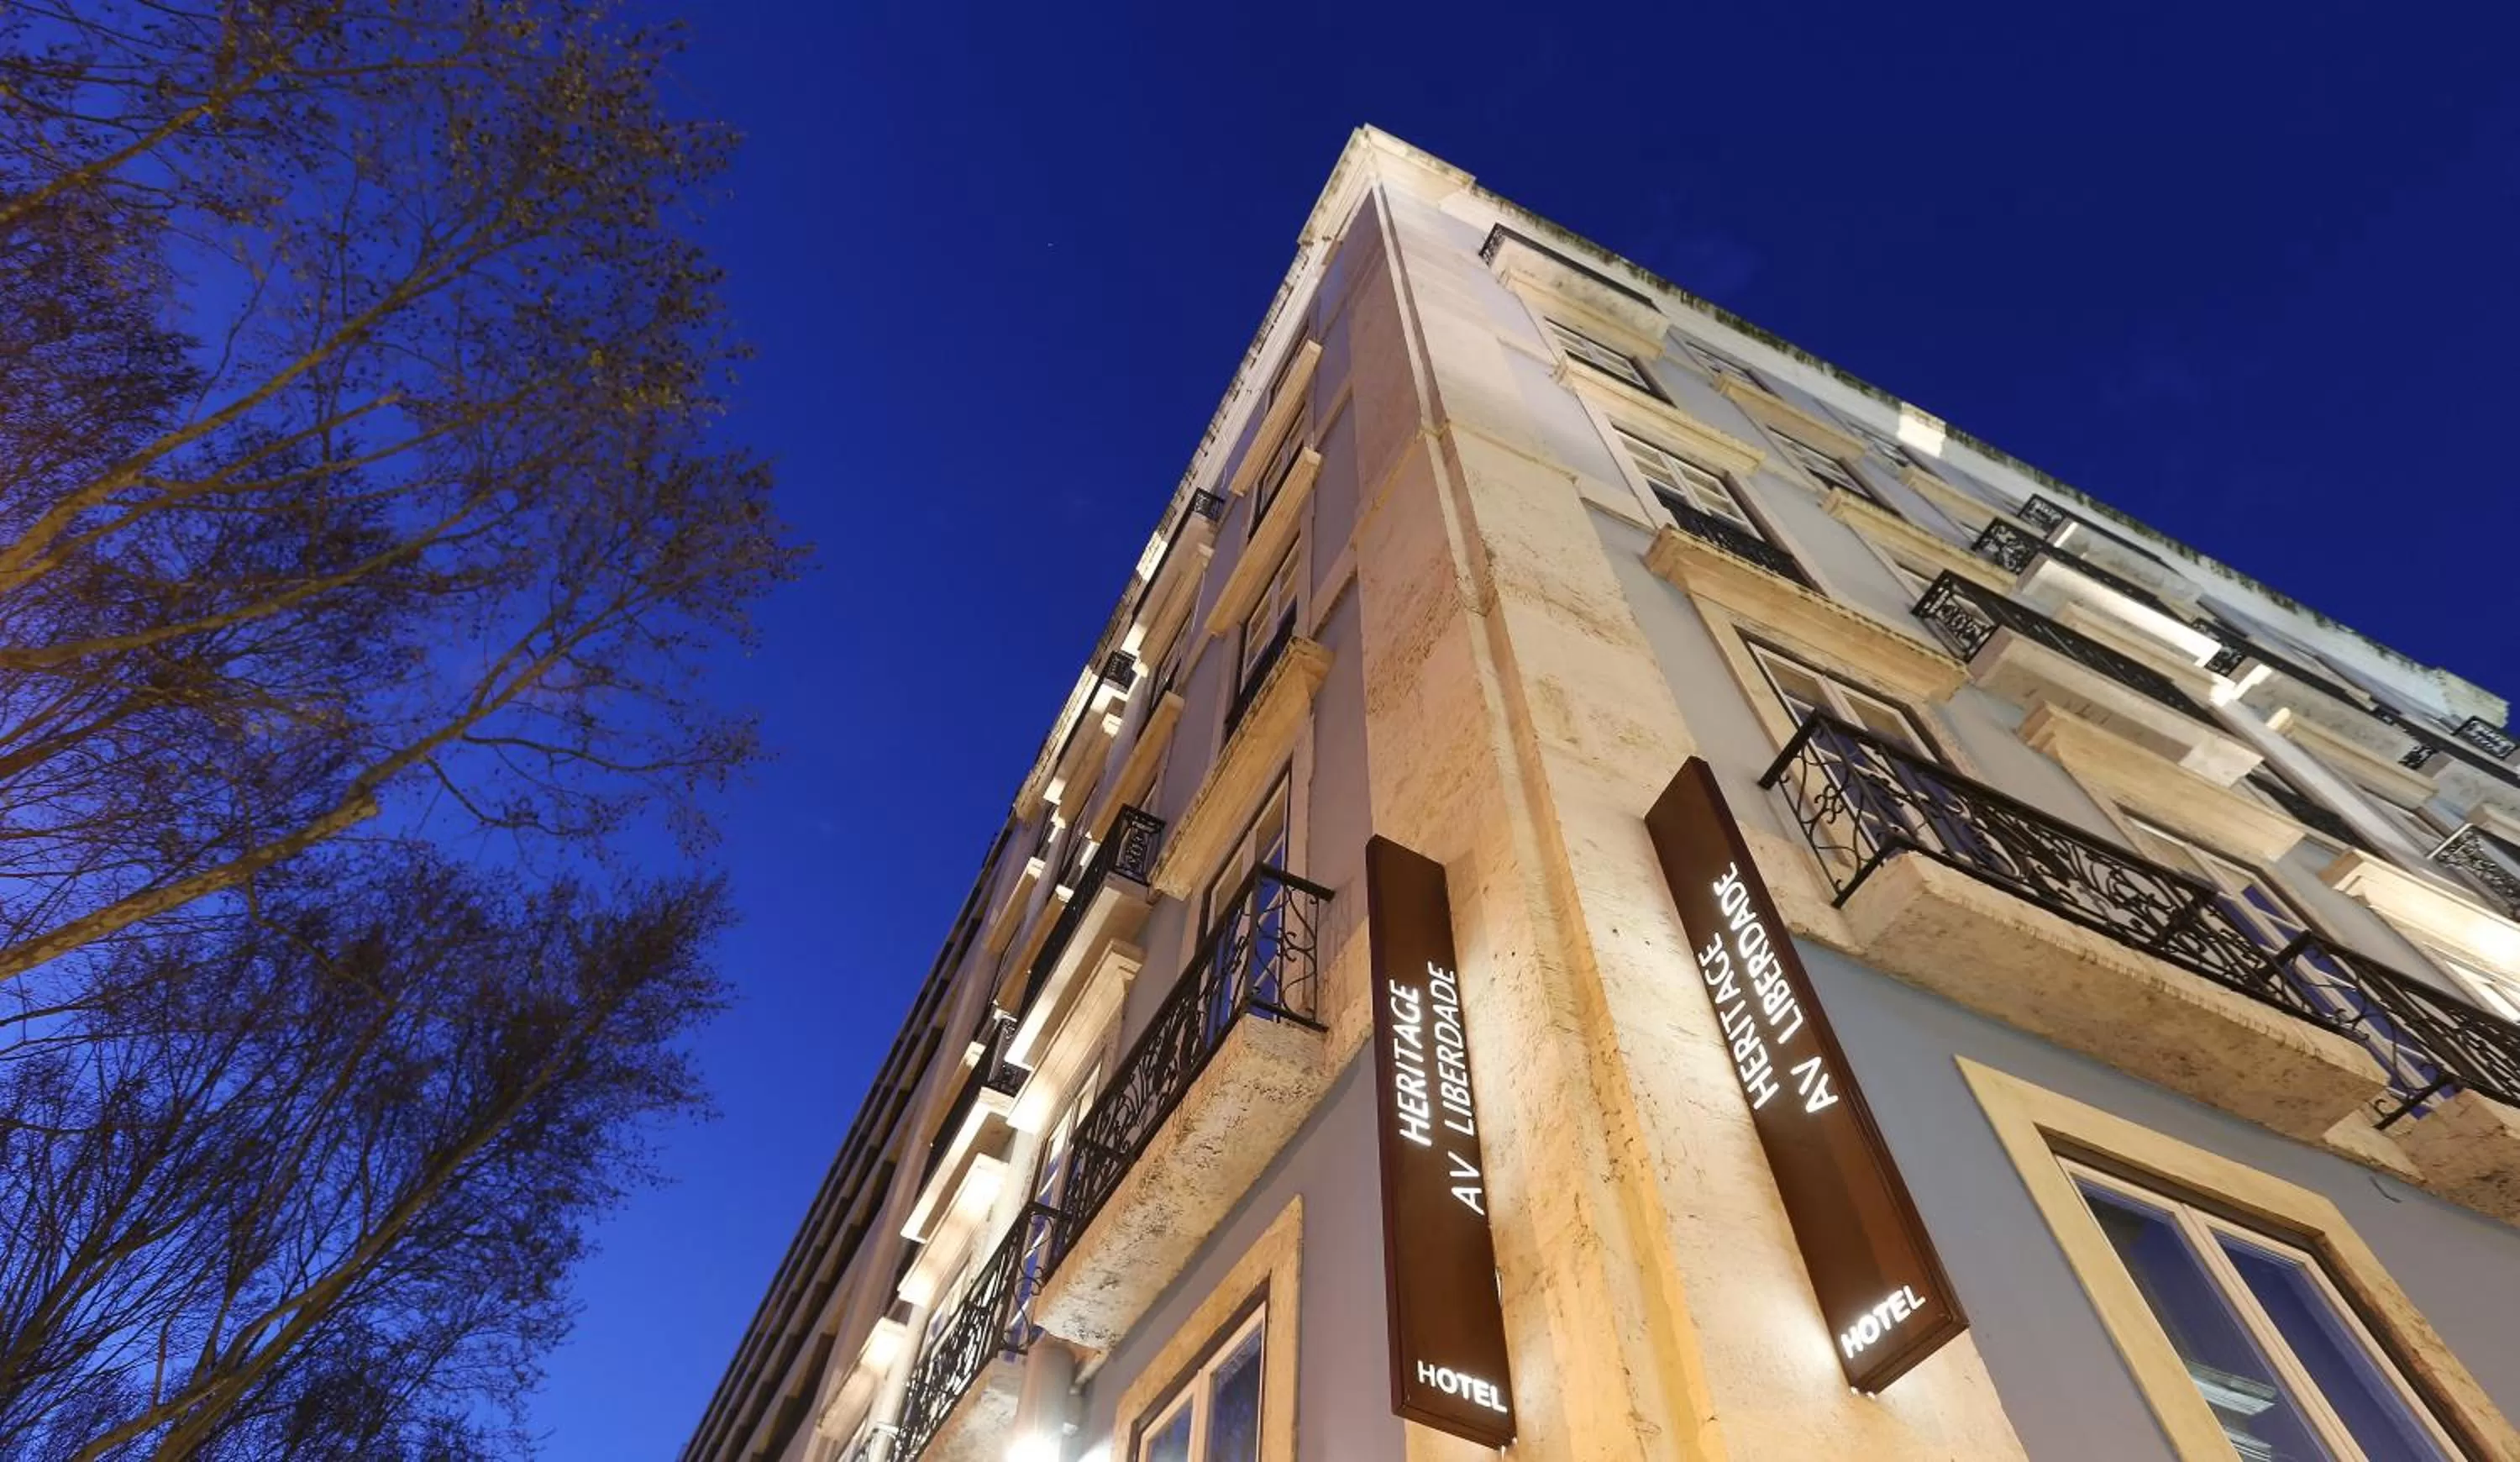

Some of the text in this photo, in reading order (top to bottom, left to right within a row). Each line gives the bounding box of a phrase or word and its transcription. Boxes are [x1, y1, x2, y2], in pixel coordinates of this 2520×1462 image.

[1389, 979, 1432, 1147] HERITAGE
[1698, 932, 1780, 1110] HERITAGE
[1712, 861, 1839, 1113] AV LIBERDADE
[1427, 961, 1484, 1215] AV LIBERDADE
[1417, 1360, 1508, 1413] HOTEL
[1839, 1285, 1926, 1359] HOTEL
